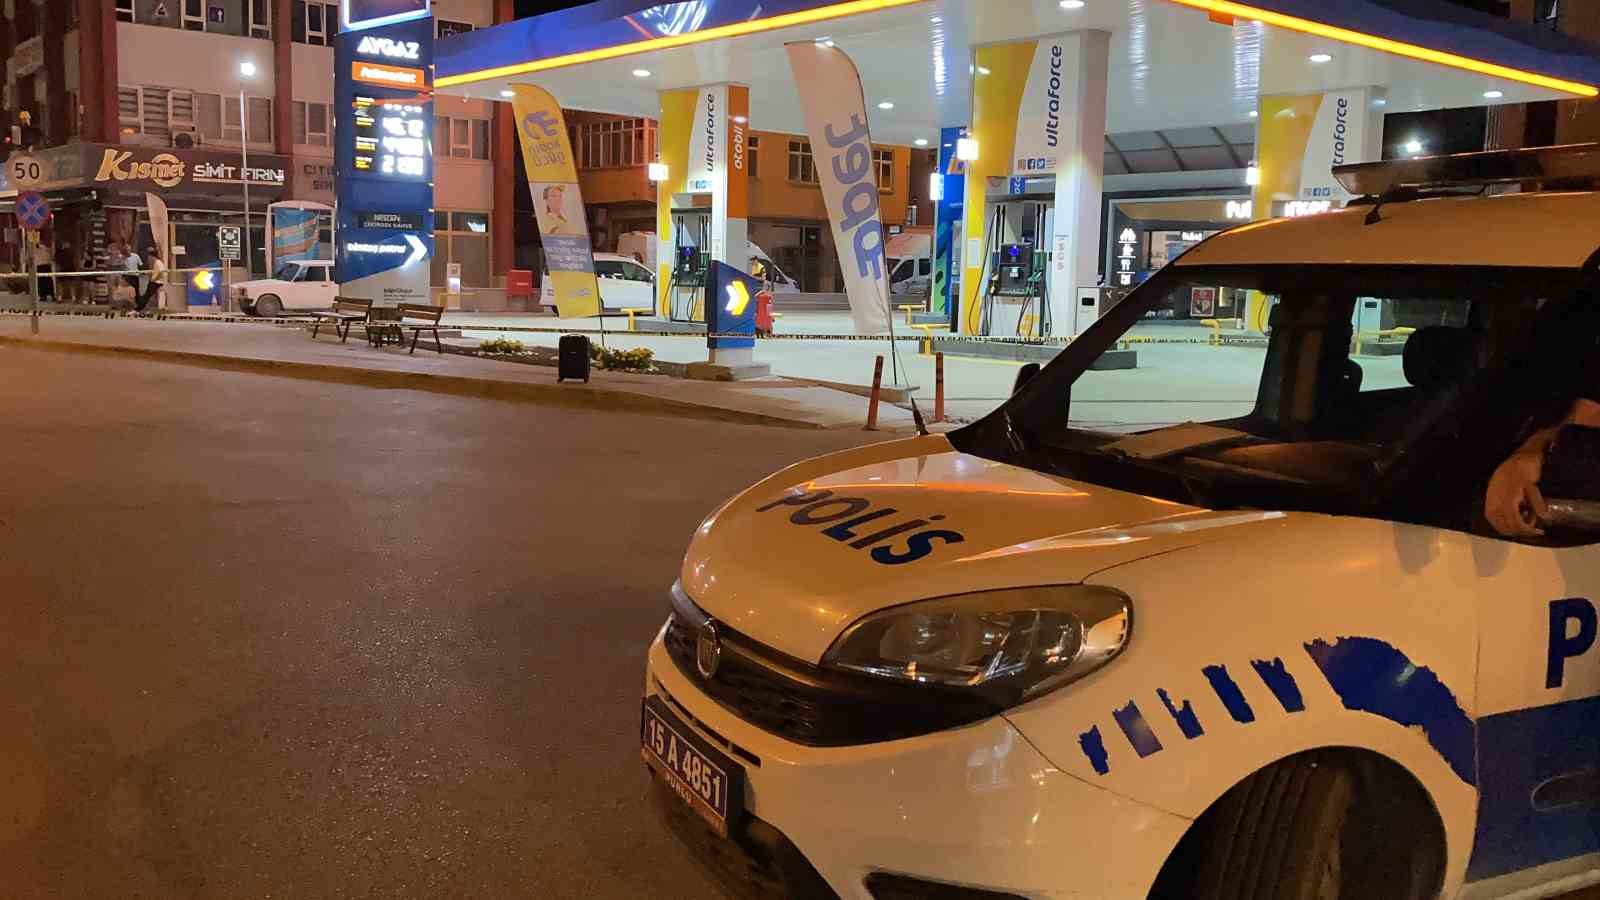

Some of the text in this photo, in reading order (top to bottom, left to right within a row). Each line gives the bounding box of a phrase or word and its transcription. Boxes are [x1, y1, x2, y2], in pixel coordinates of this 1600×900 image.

[705, 93, 716, 172] ultraforce
[1047, 45, 1063, 148] ultraforce
[15, 162, 40, 180] 50
[733, 125, 744, 170] otobil
[755, 490, 965, 565] POLİS
[650, 718, 665, 756] 15
[668, 735, 679, 771] A
[682, 750, 721, 808] 4851
